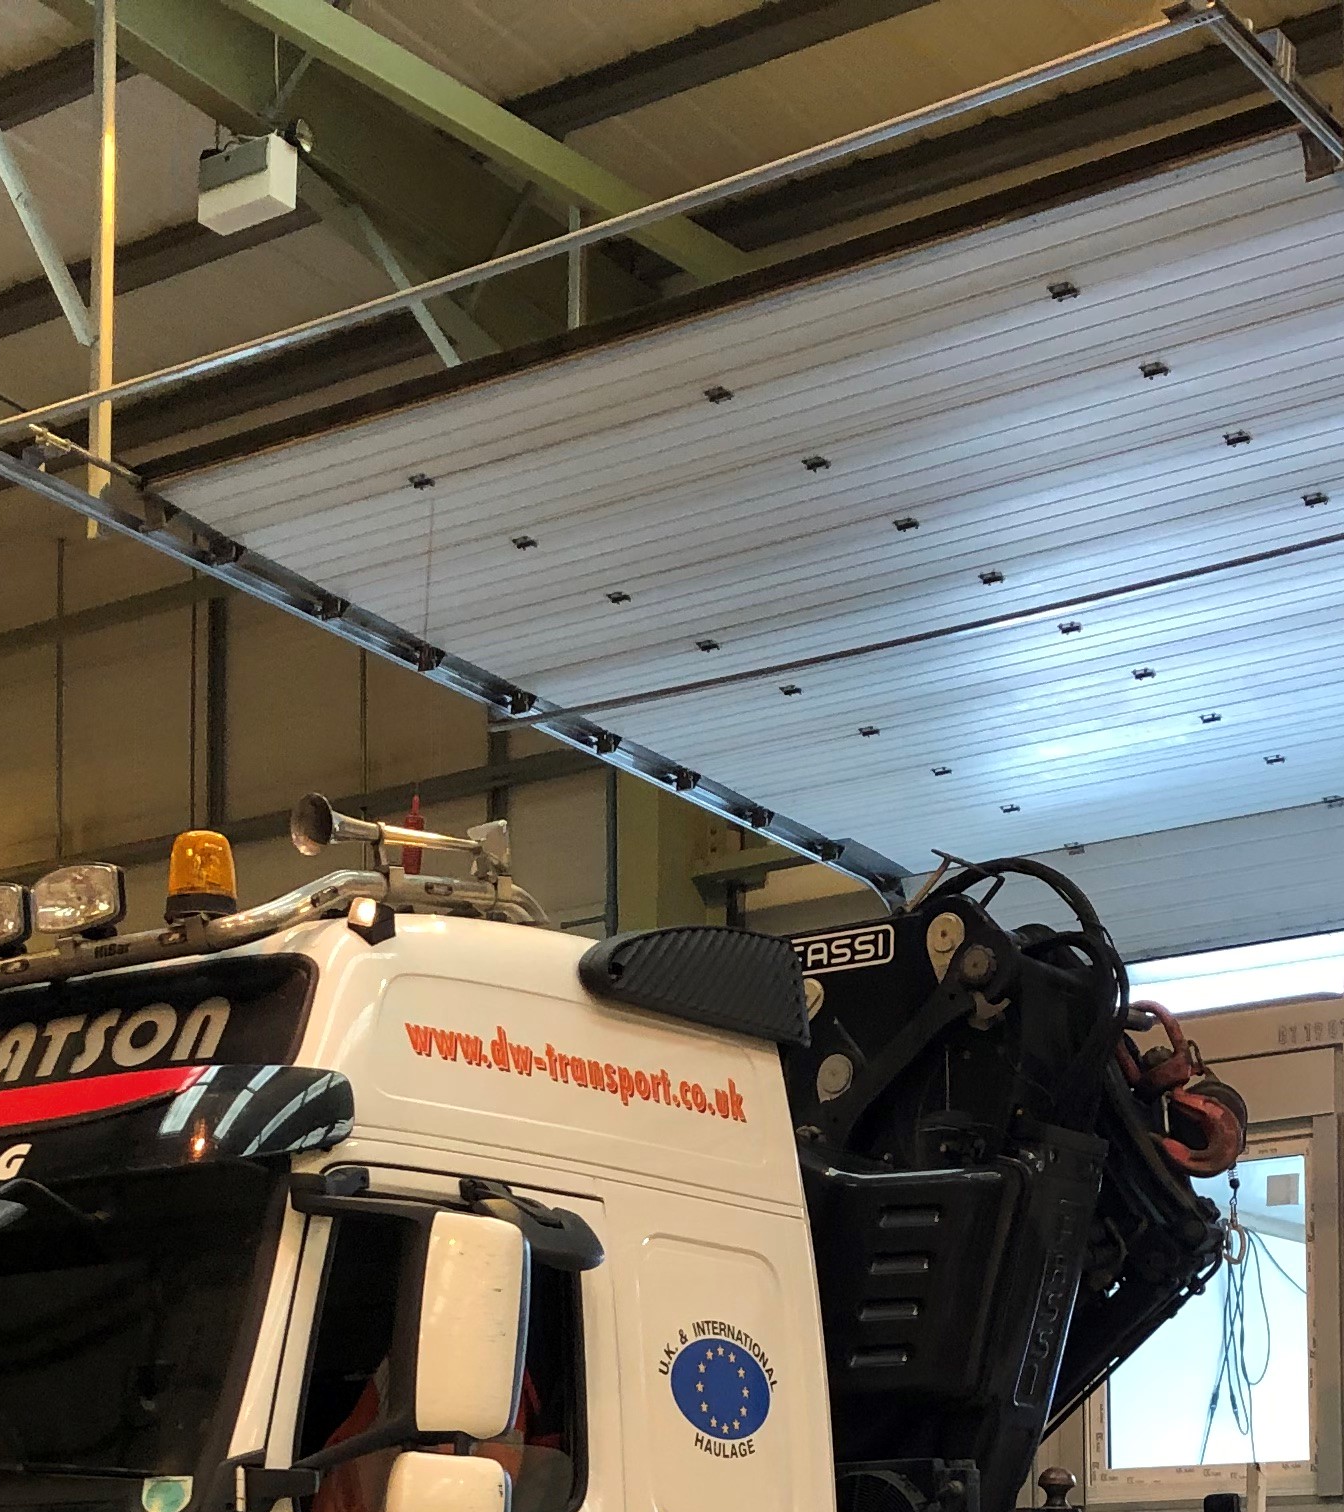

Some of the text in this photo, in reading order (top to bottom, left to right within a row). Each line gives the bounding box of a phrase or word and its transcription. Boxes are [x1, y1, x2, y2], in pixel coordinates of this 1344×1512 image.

[405, 1022, 747, 1123] www.dw-transport.co.uk
[658, 1320, 778, 1393] U.K. & INTERNATIONAL
[694, 1432, 756, 1459] HAULAGE
